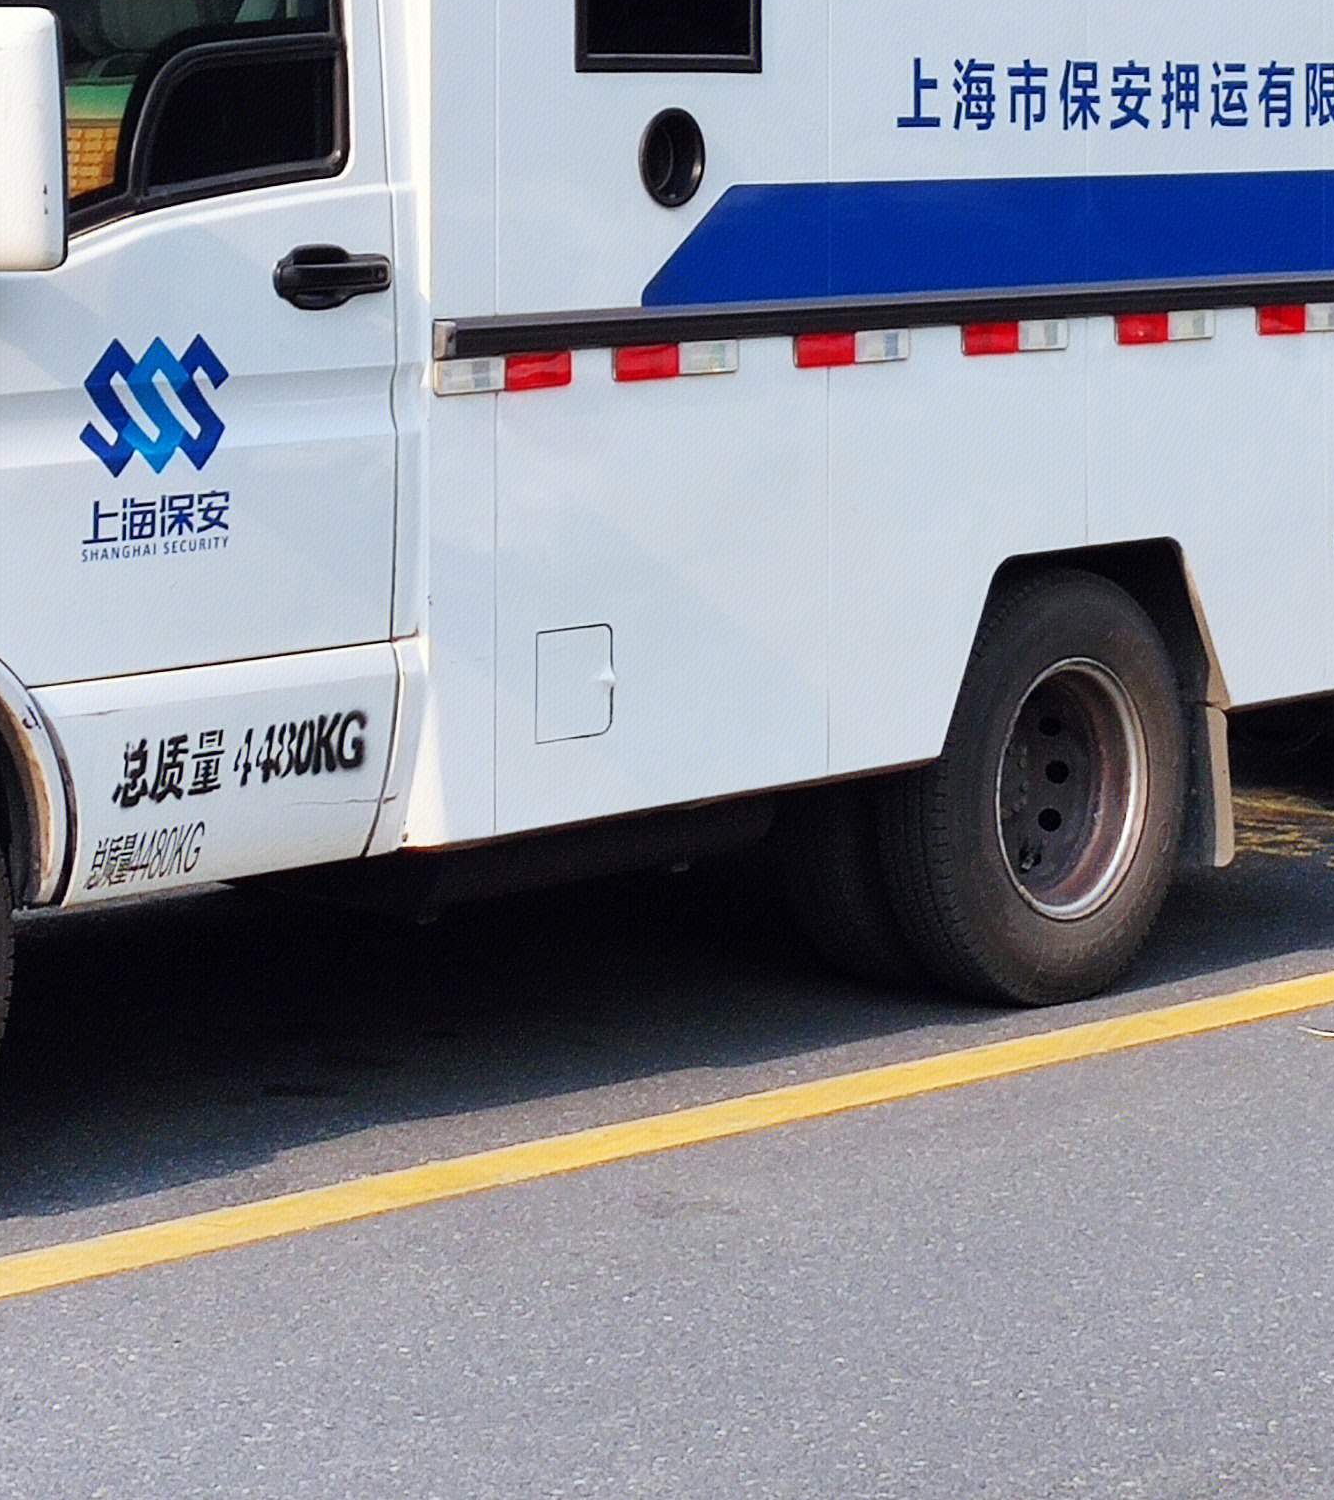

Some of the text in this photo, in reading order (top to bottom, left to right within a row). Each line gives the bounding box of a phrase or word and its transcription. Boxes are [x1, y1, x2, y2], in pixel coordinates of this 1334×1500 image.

[82, 490, 230, 544] 上海保安
[81, 536, 229, 562] SHANGHAI SECURITY
[112, 710, 368, 808] 总质量 4480KG
